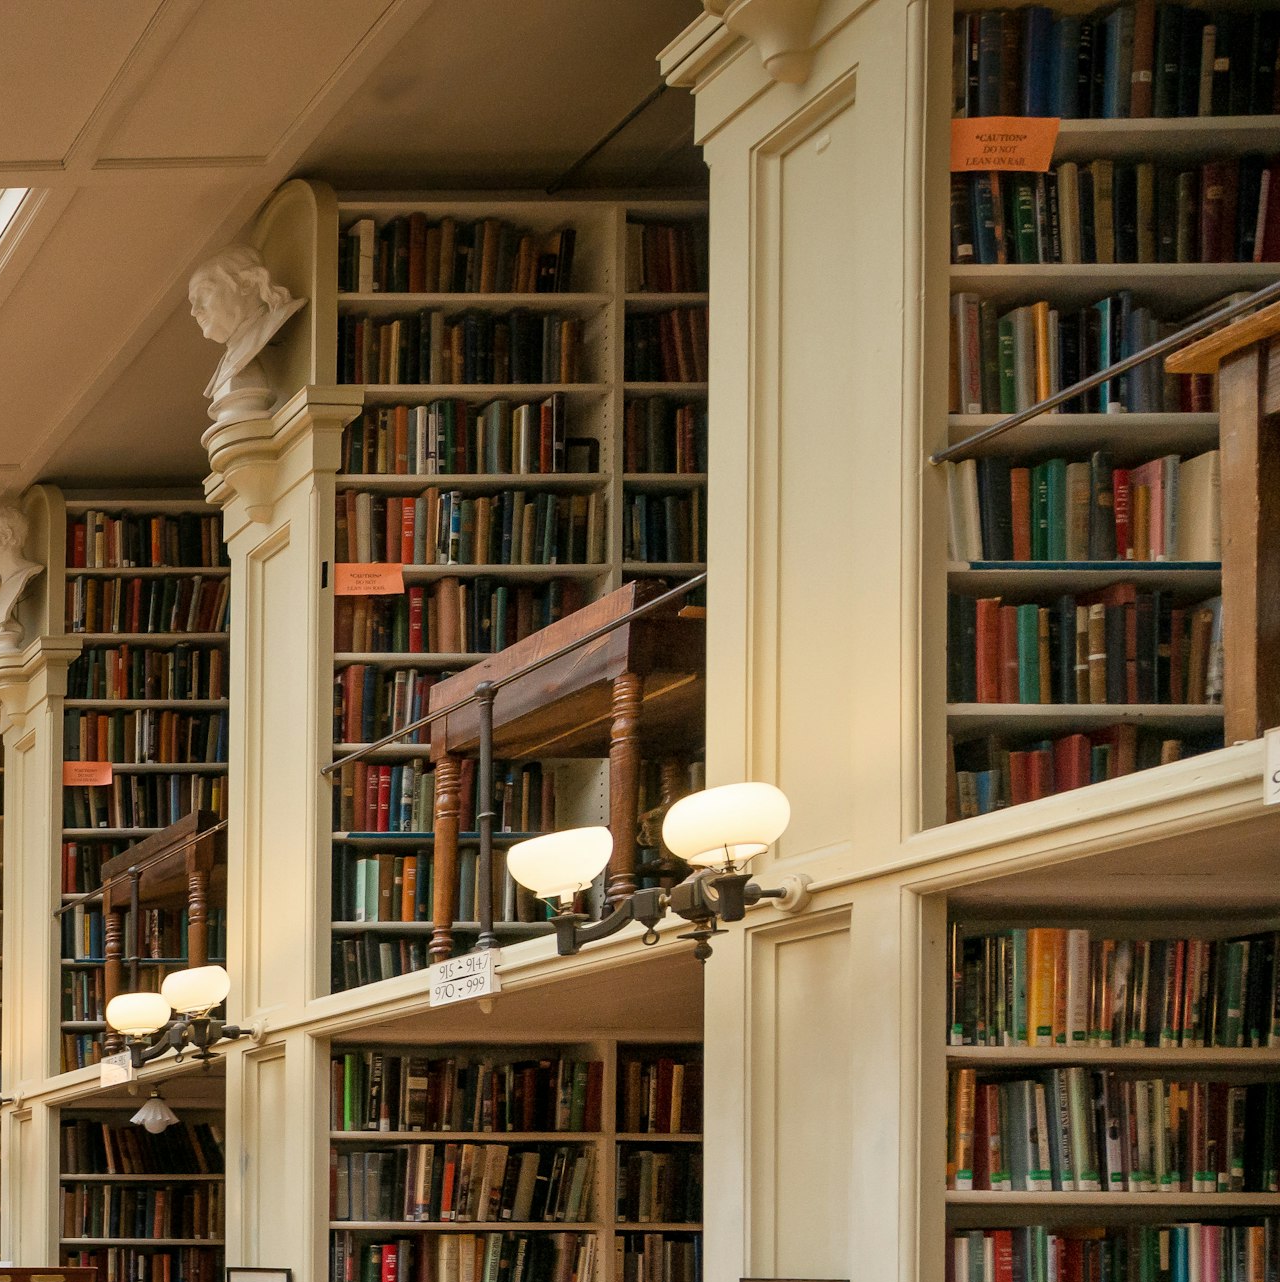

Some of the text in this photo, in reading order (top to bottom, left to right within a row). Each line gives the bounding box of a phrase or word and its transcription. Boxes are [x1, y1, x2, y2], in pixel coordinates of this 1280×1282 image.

[983, 146, 998, 154] DO
[966, 158, 991, 166] LEAN
[1007, 158, 1025, 166] RAIL
[440, 962, 454, 980] 915
[435, 976, 485, 1001] 970 999
